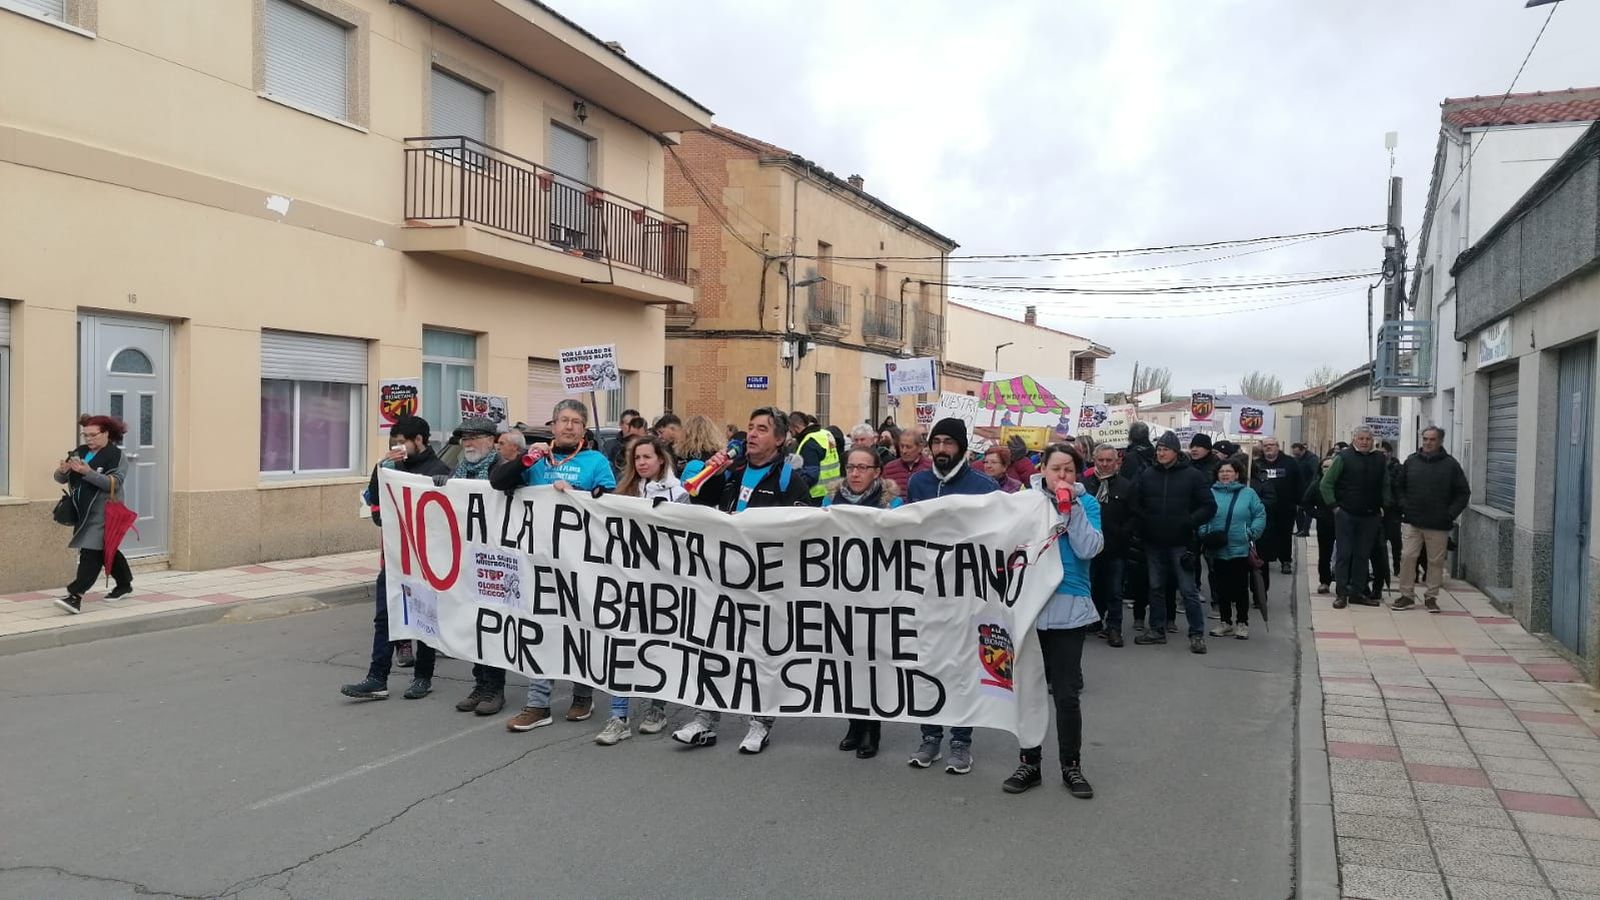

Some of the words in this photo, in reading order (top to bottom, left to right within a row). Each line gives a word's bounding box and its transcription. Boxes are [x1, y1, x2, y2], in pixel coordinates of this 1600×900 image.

[562, 354, 593, 363] NUESTROS
[594, 352, 612, 360] HIJOS
[564, 363, 591, 374] STOP
[565, 375, 593, 383] OLORES
[461, 397, 488, 413] NO
[386, 483, 461, 591] NO
[466, 493, 487, 544] A
[500, 494, 534, 554] LA
[552, 504, 713, 581] PLANTA
[719, 541, 784, 592] DE
[800, 536, 1028, 607] BIOMETANO
[477, 568, 504, 580] STOP
[477, 581, 505, 590] OLORES
[533, 566, 581, 621] EN
[593, 576, 918, 661] BABILAFUENTE
[476, 607, 544, 675] POR
[563, 625, 761, 712] NUESTRA
[779, 657, 946, 717] SALUD
